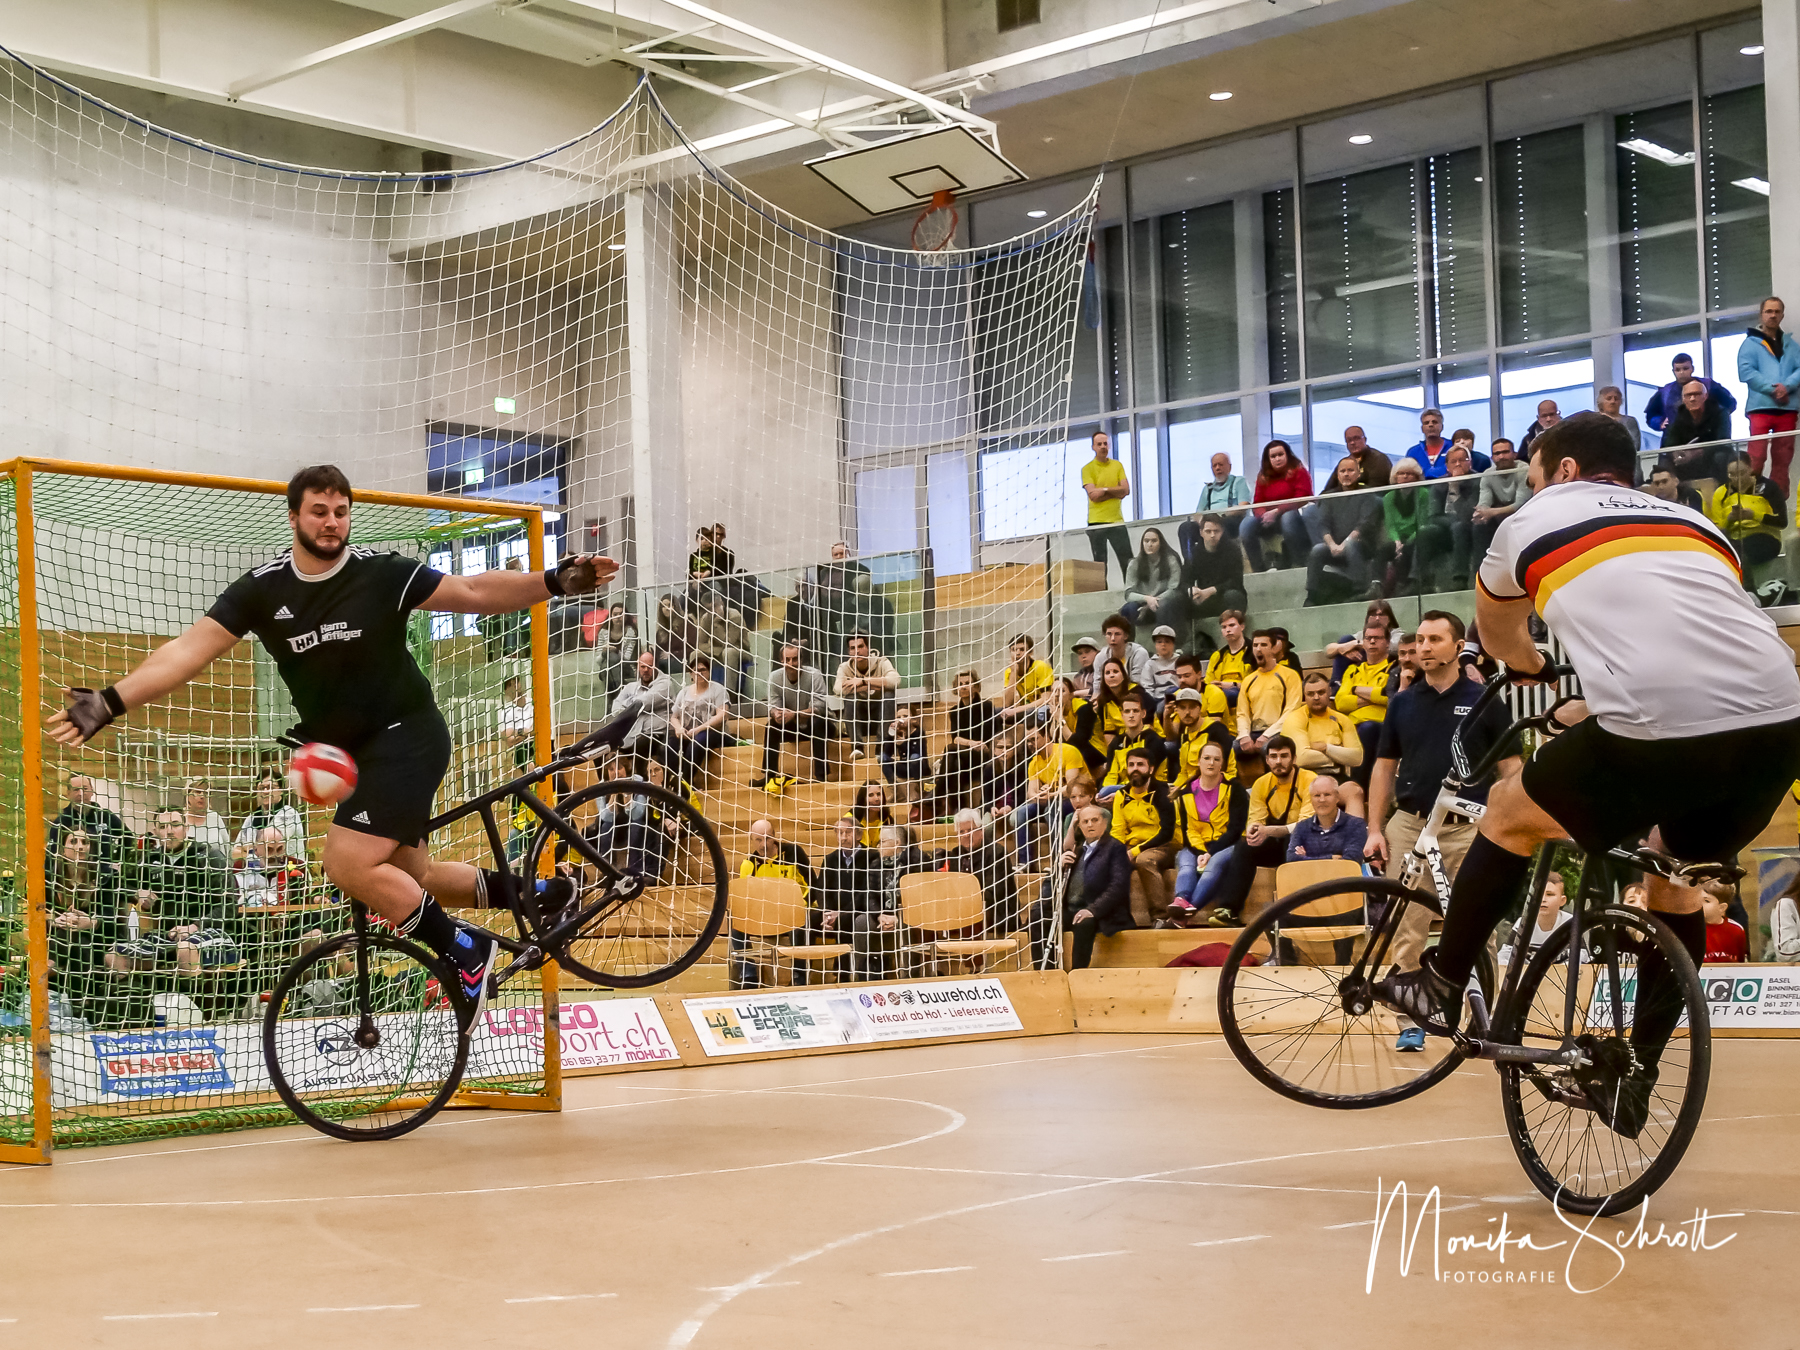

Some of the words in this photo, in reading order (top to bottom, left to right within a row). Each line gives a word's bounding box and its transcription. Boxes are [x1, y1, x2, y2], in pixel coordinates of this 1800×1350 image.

[320, 621, 348, 633] Harro
[916, 985, 1003, 1005] buurehof.ch
[867, 1012, 909, 1024] Verkauf
[911, 1010, 924, 1021] ab
[924, 1008, 943, 1019] Hof
[949, 1005, 1010, 1018] Lieferservice
[1734, 1004, 1757, 1016] AG
[753, 1014, 816, 1030] SCHWAB
[722, 1026, 745, 1039] AG
[778, 1028, 801, 1041] AG
[561, 1057, 578, 1067] 061
[580, 1056, 596, 1065] 851
[595, 1054, 609, 1064] 33
[608, 1053, 620, 1062] 77
[304, 1076, 338, 1088] AUTO
